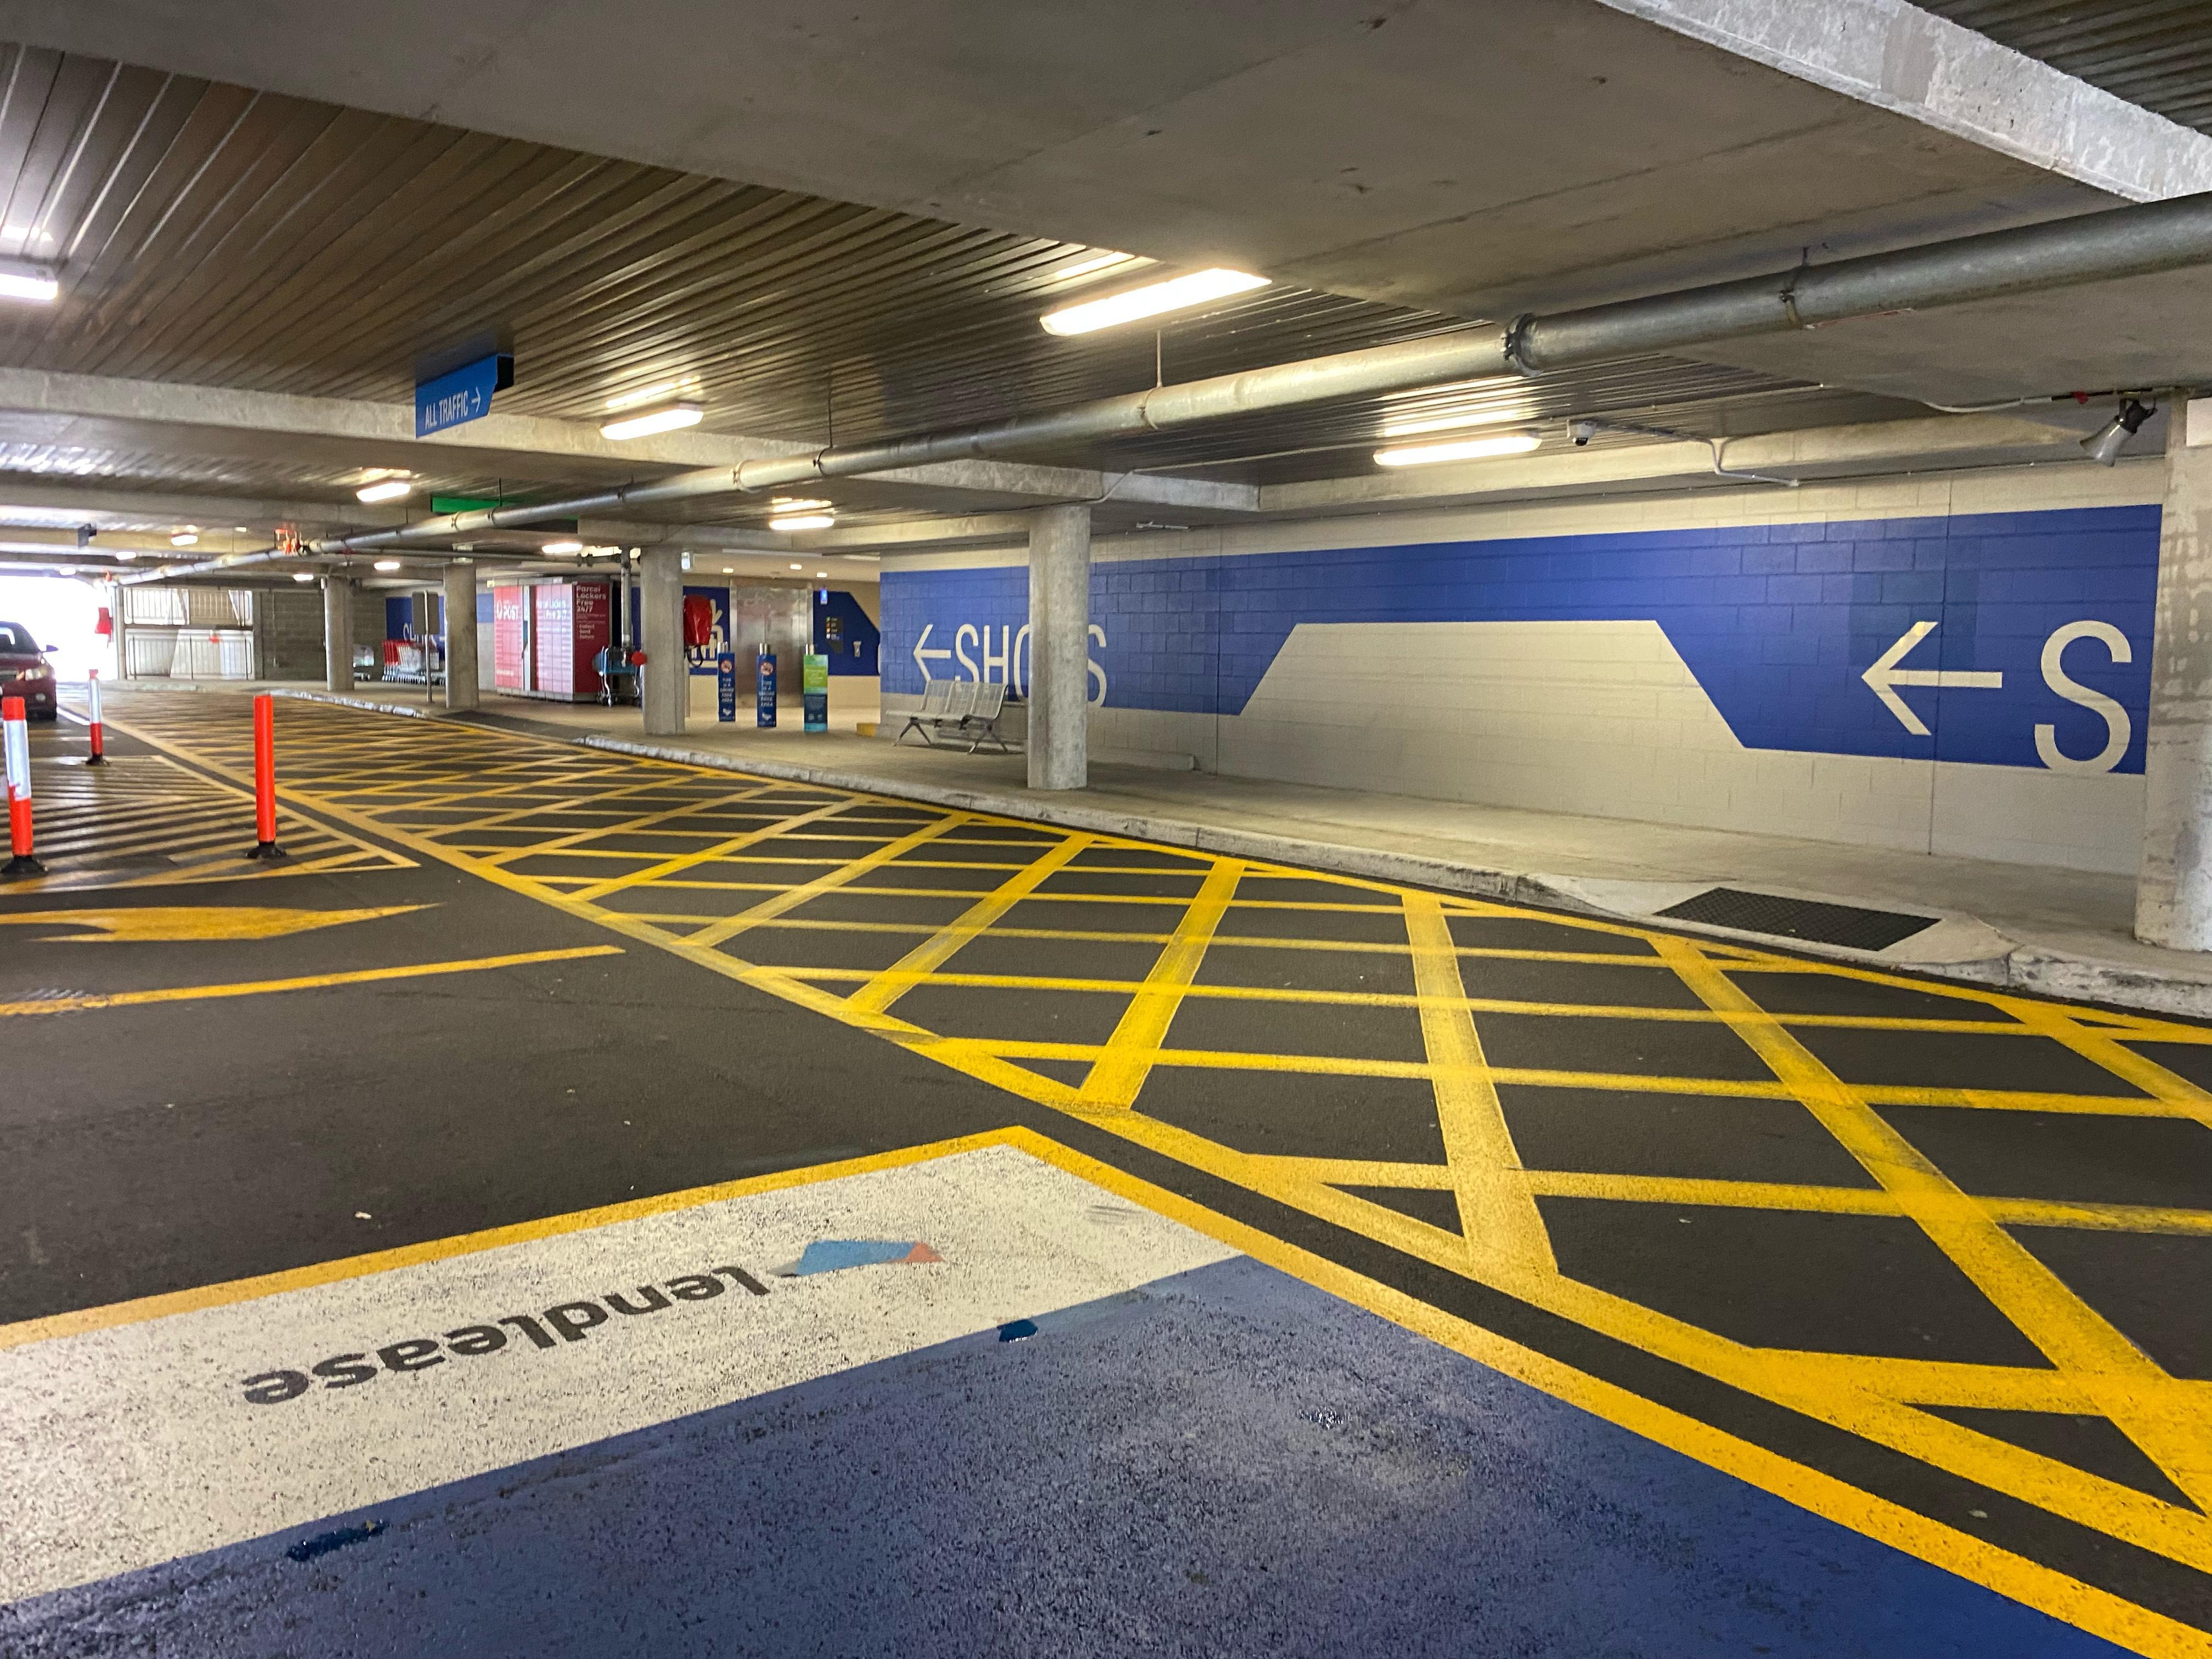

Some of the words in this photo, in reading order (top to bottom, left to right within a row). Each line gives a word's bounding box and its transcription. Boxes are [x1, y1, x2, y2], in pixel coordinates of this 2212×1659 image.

[425, 402, 437, 430] ALL
[439, 390, 469, 425] TRAFFIC
[503, 605, 520, 620] POST
[955, 623, 1107, 707] SHOS
[241, 1266, 769, 1404] lendlease
